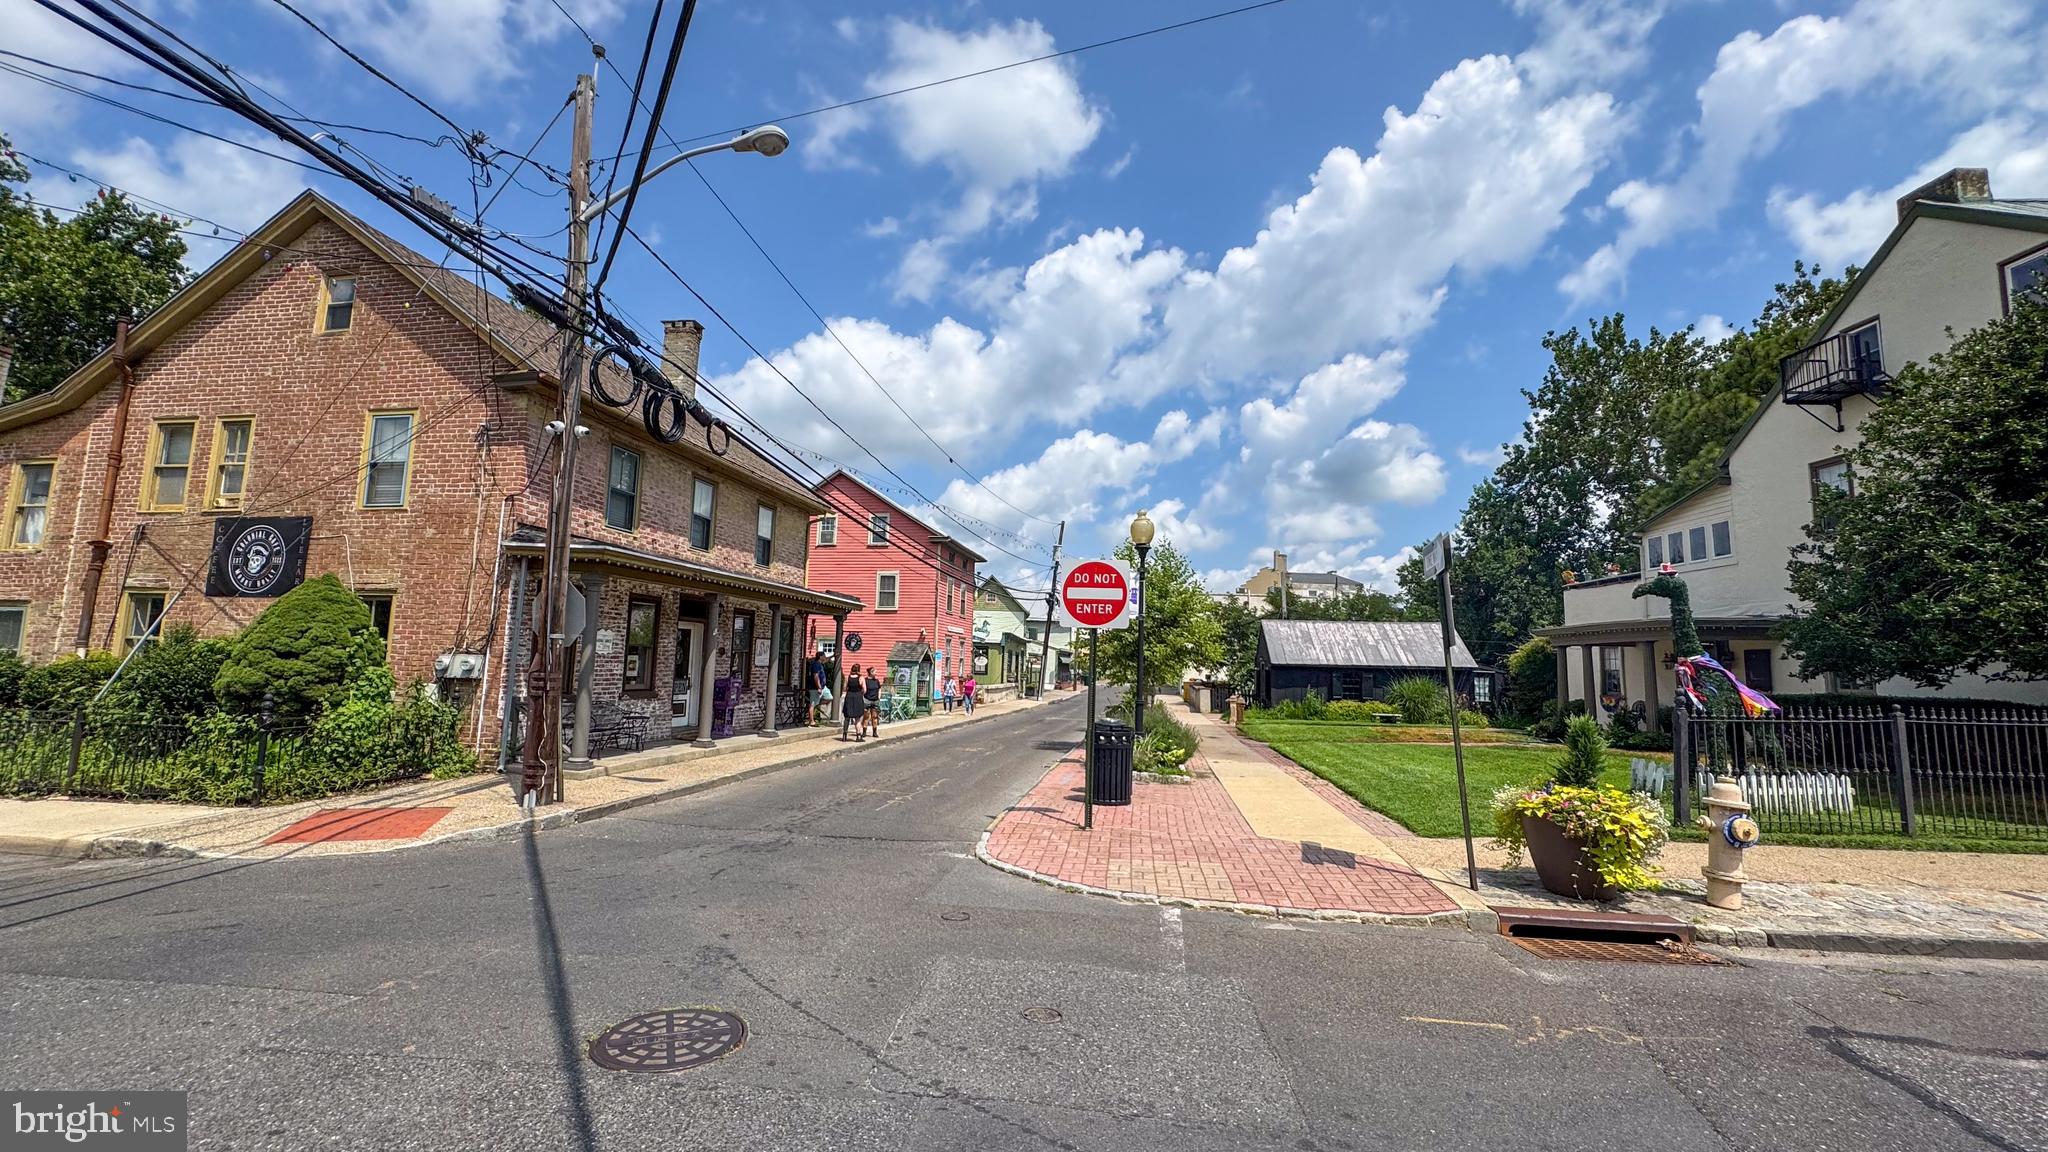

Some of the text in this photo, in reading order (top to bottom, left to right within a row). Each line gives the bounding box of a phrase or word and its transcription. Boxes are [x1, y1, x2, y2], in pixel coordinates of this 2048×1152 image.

[236, 531, 266, 552] COLONIAL
[1074, 573, 1117, 584] DO NOT
[1076, 603, 1113, 615] ENTER
